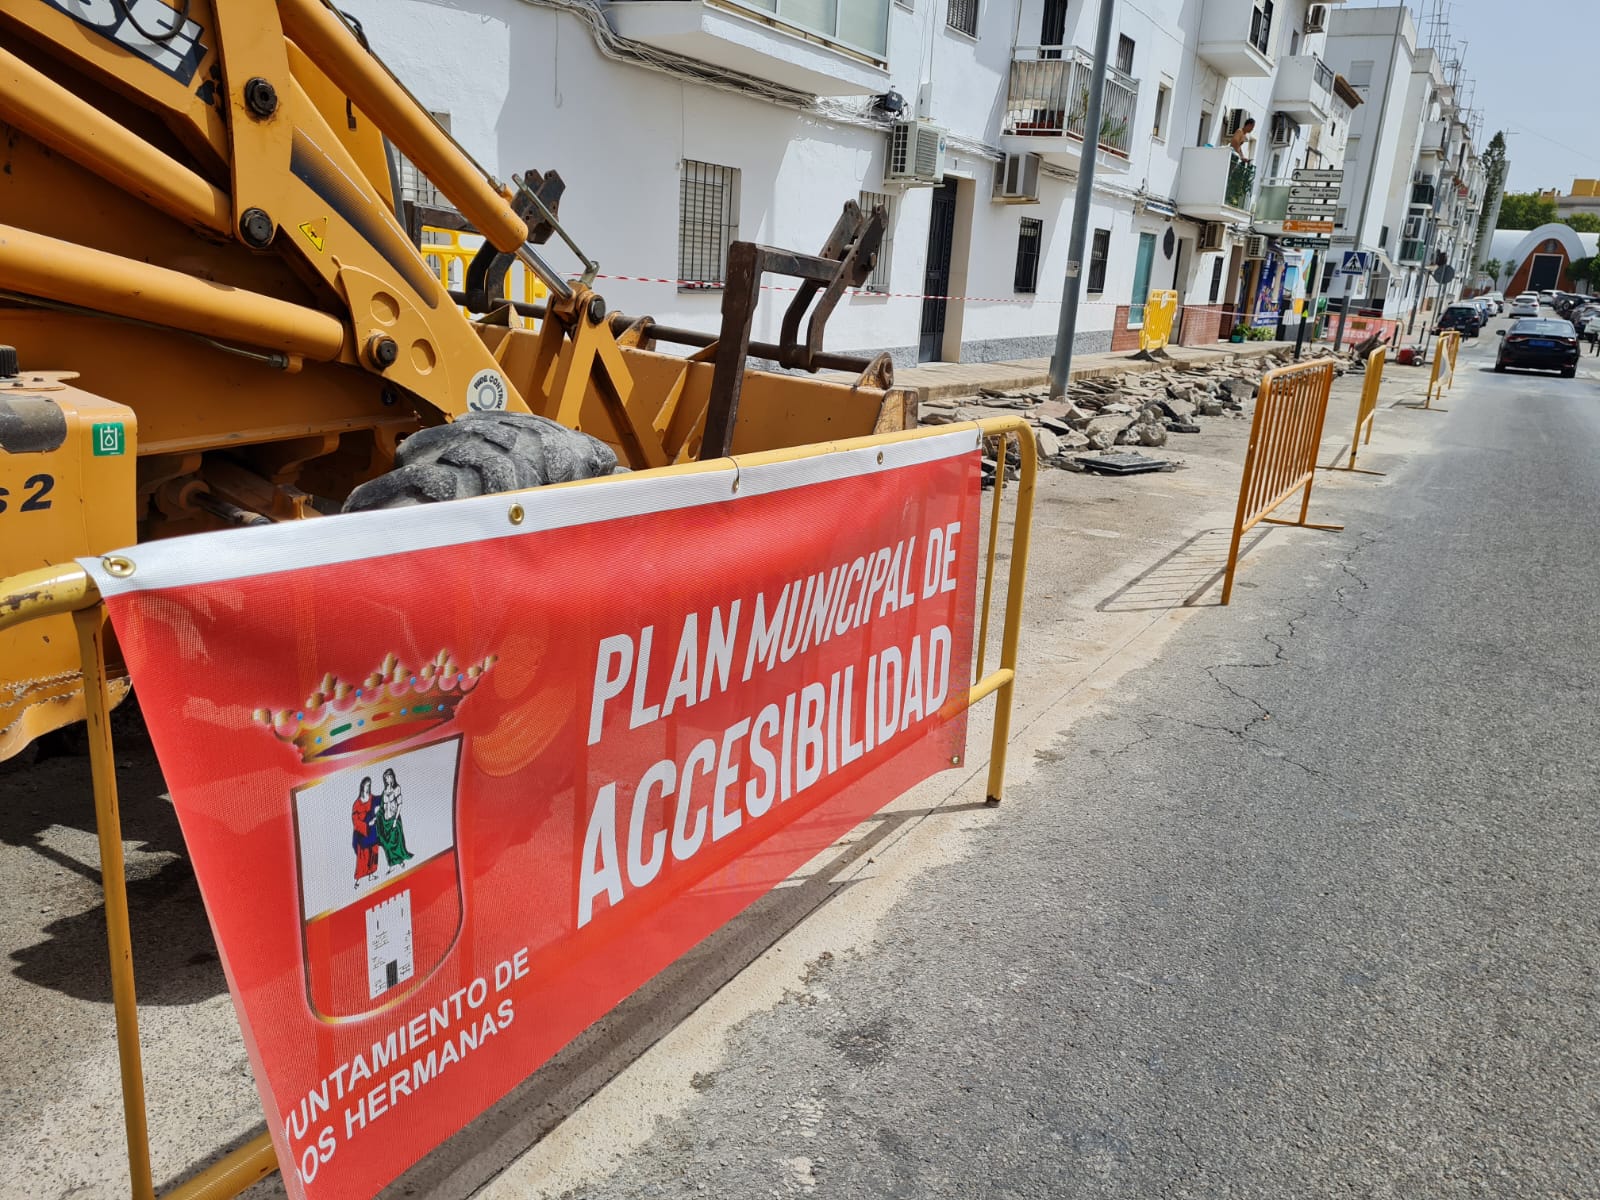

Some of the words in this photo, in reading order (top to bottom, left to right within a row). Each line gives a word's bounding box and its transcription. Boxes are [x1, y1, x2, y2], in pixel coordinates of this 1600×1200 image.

[473, 375, 488, 390] RIDE
[489, 375, 504, 409] CONTROL
[20, 473, 55, 513] 2
[587, 599, 741, 746] PLAN
[742, 536, 916, 682] MUNICIPAL
[922, 521, 961, 600] DE
[577, 624, 952, 929] ACCESIBILIDAD
[494, 947, 530, 992] DE
[297, 1125, 337, 1184] OS
[344, 998, 515, 1140] HERMANAS
